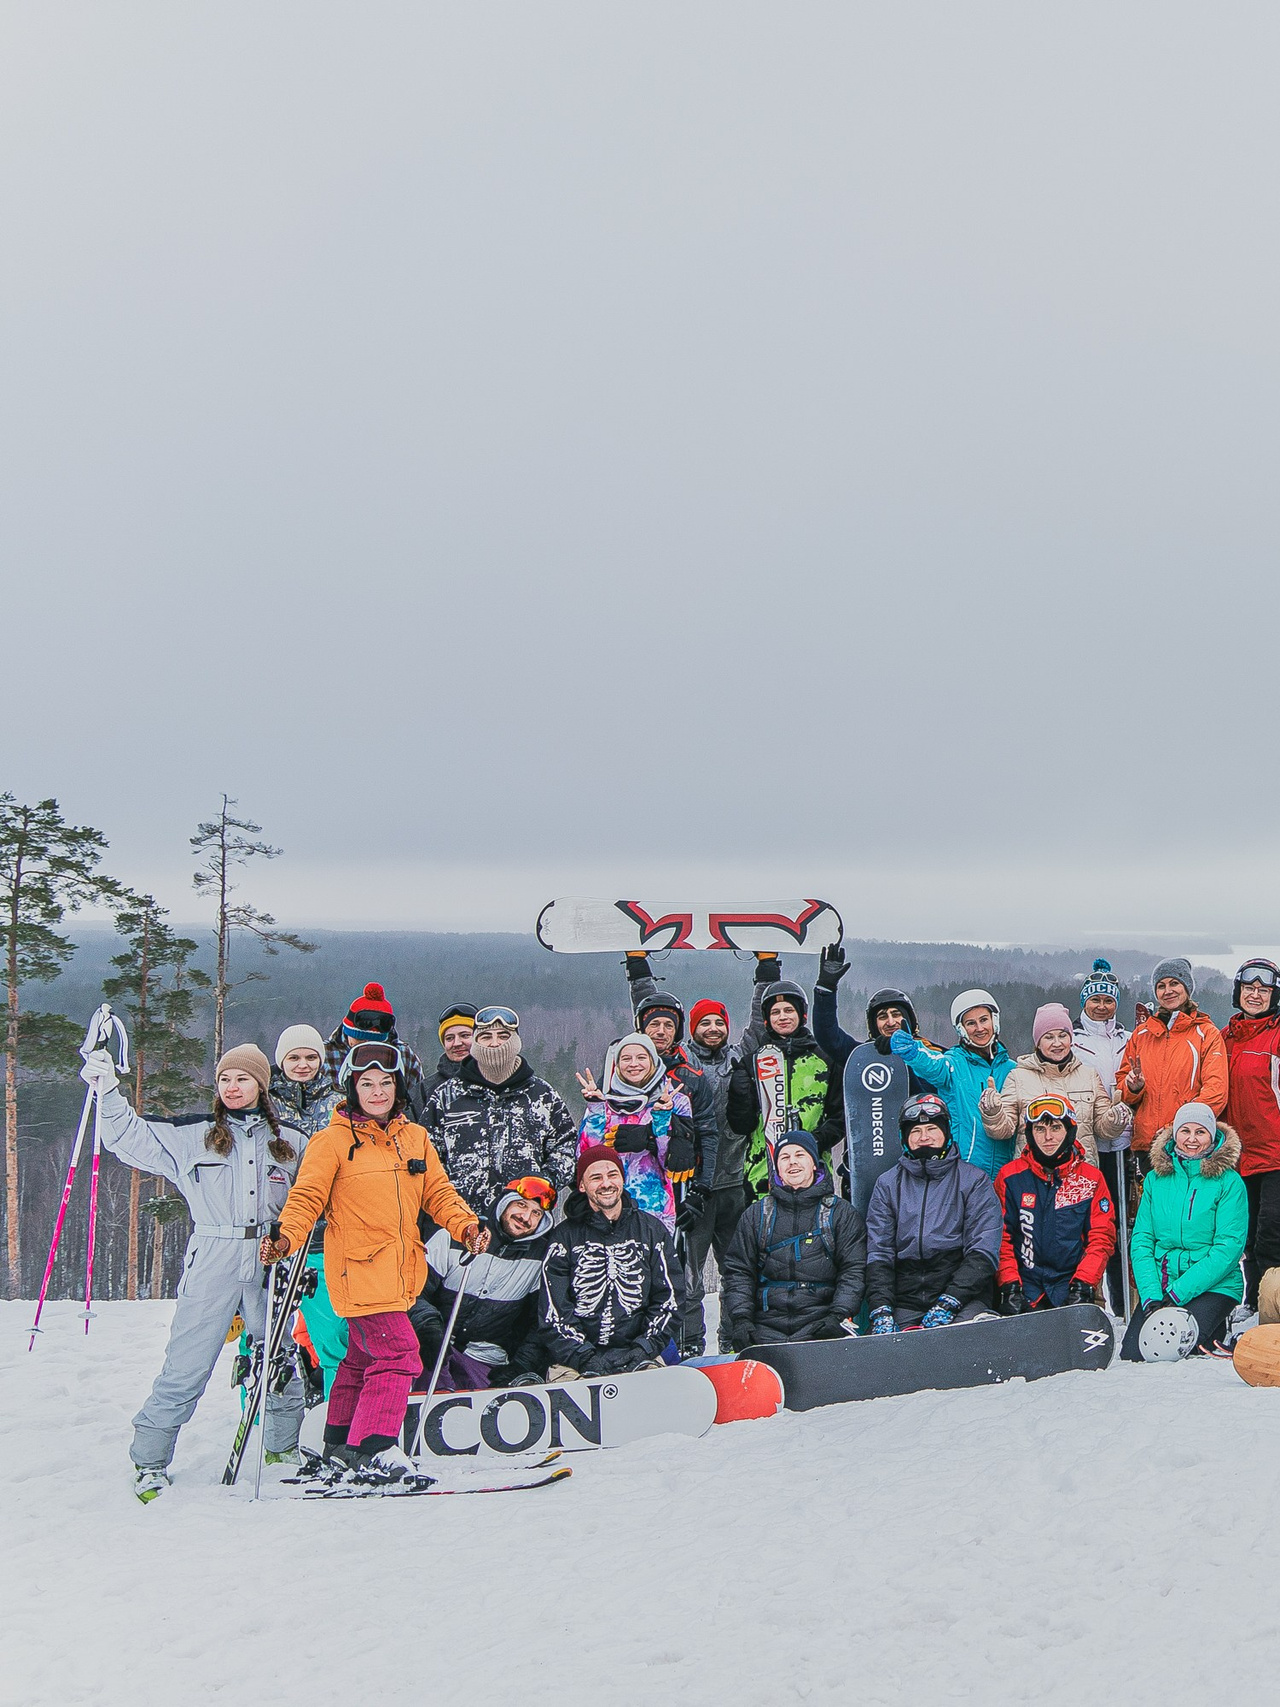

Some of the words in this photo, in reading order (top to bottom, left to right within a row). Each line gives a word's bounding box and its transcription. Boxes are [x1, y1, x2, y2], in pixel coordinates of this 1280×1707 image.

[1082, 983, 1118, 999] SOCHI
[871, 1097, 884, 1157] NIDECKER
[403, 1383, 604, 1456] ICON
